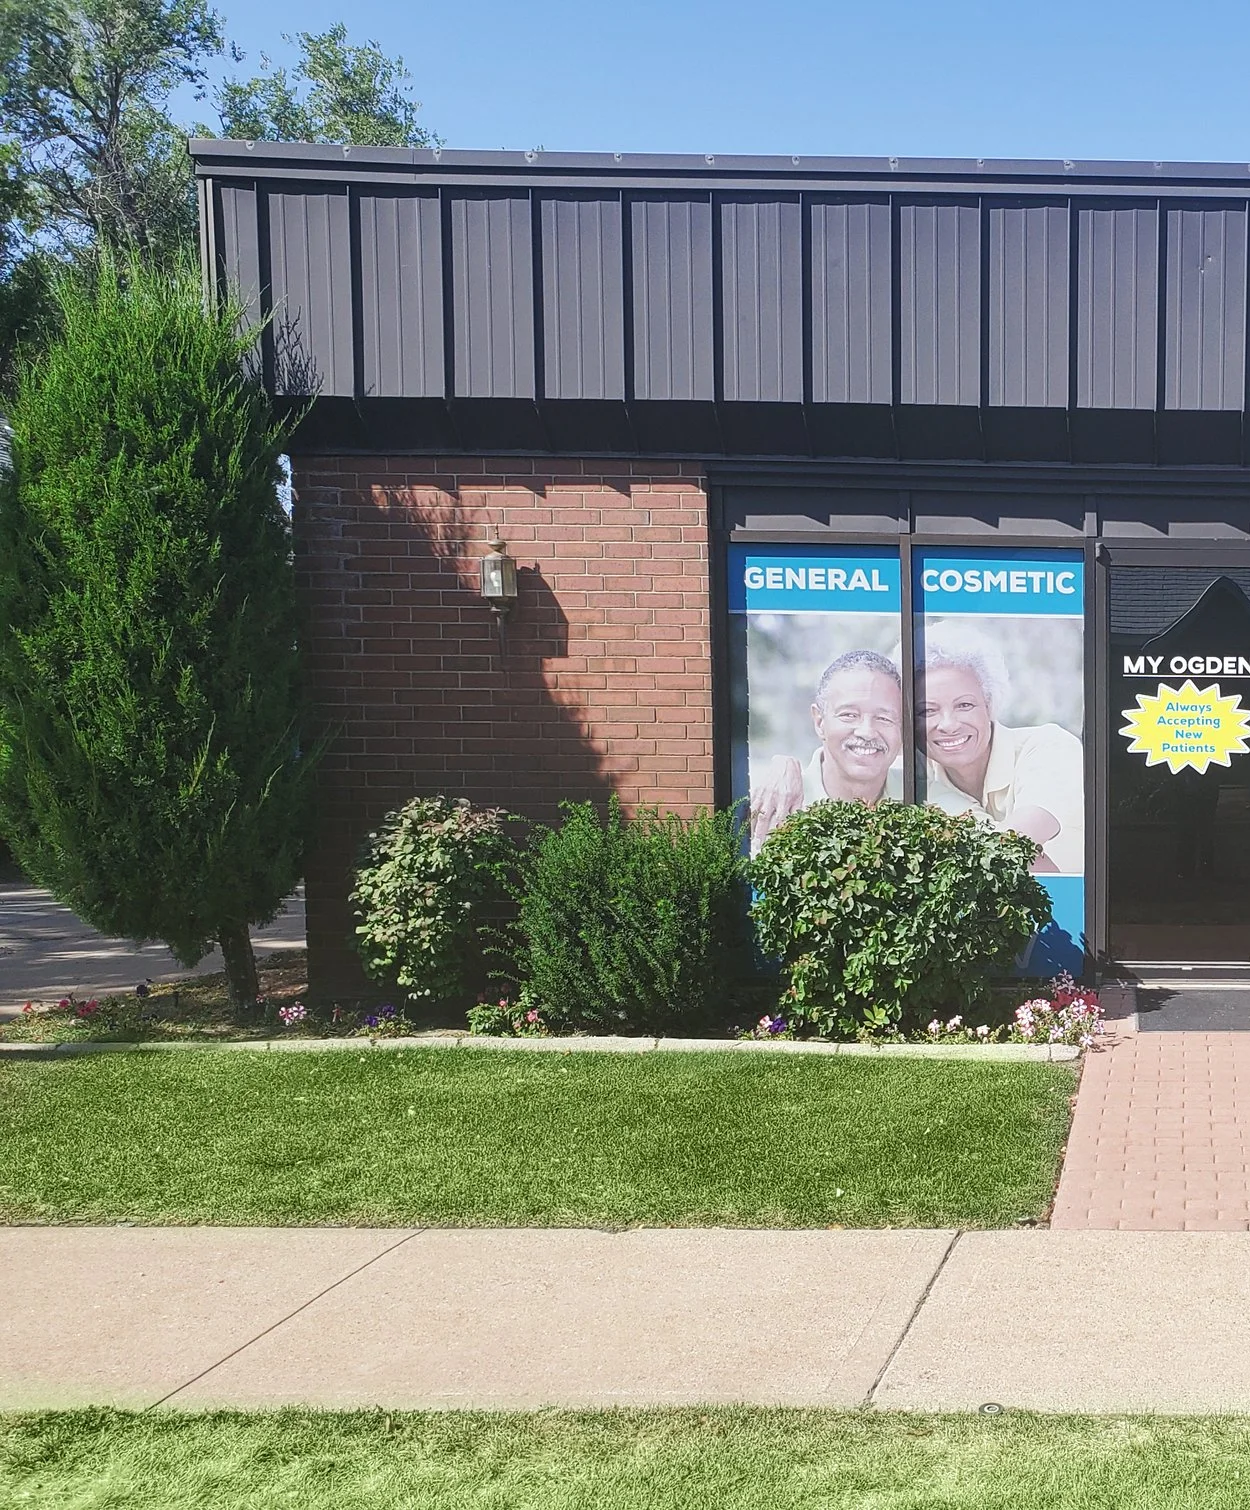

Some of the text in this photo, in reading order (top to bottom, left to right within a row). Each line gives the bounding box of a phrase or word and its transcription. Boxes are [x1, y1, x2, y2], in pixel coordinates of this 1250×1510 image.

[743, 566, 889, 592] GENERAL
[921, 568, 1076, 595] COSMETIC
[1123, 655, 1165, 674] MY
[1165, 702, 1212, 714] Always
[1157, 716, 1221, 729] Accepting
[1175, 729, 1203, 739] New
[1162, 743, 1216, 753] Patients
